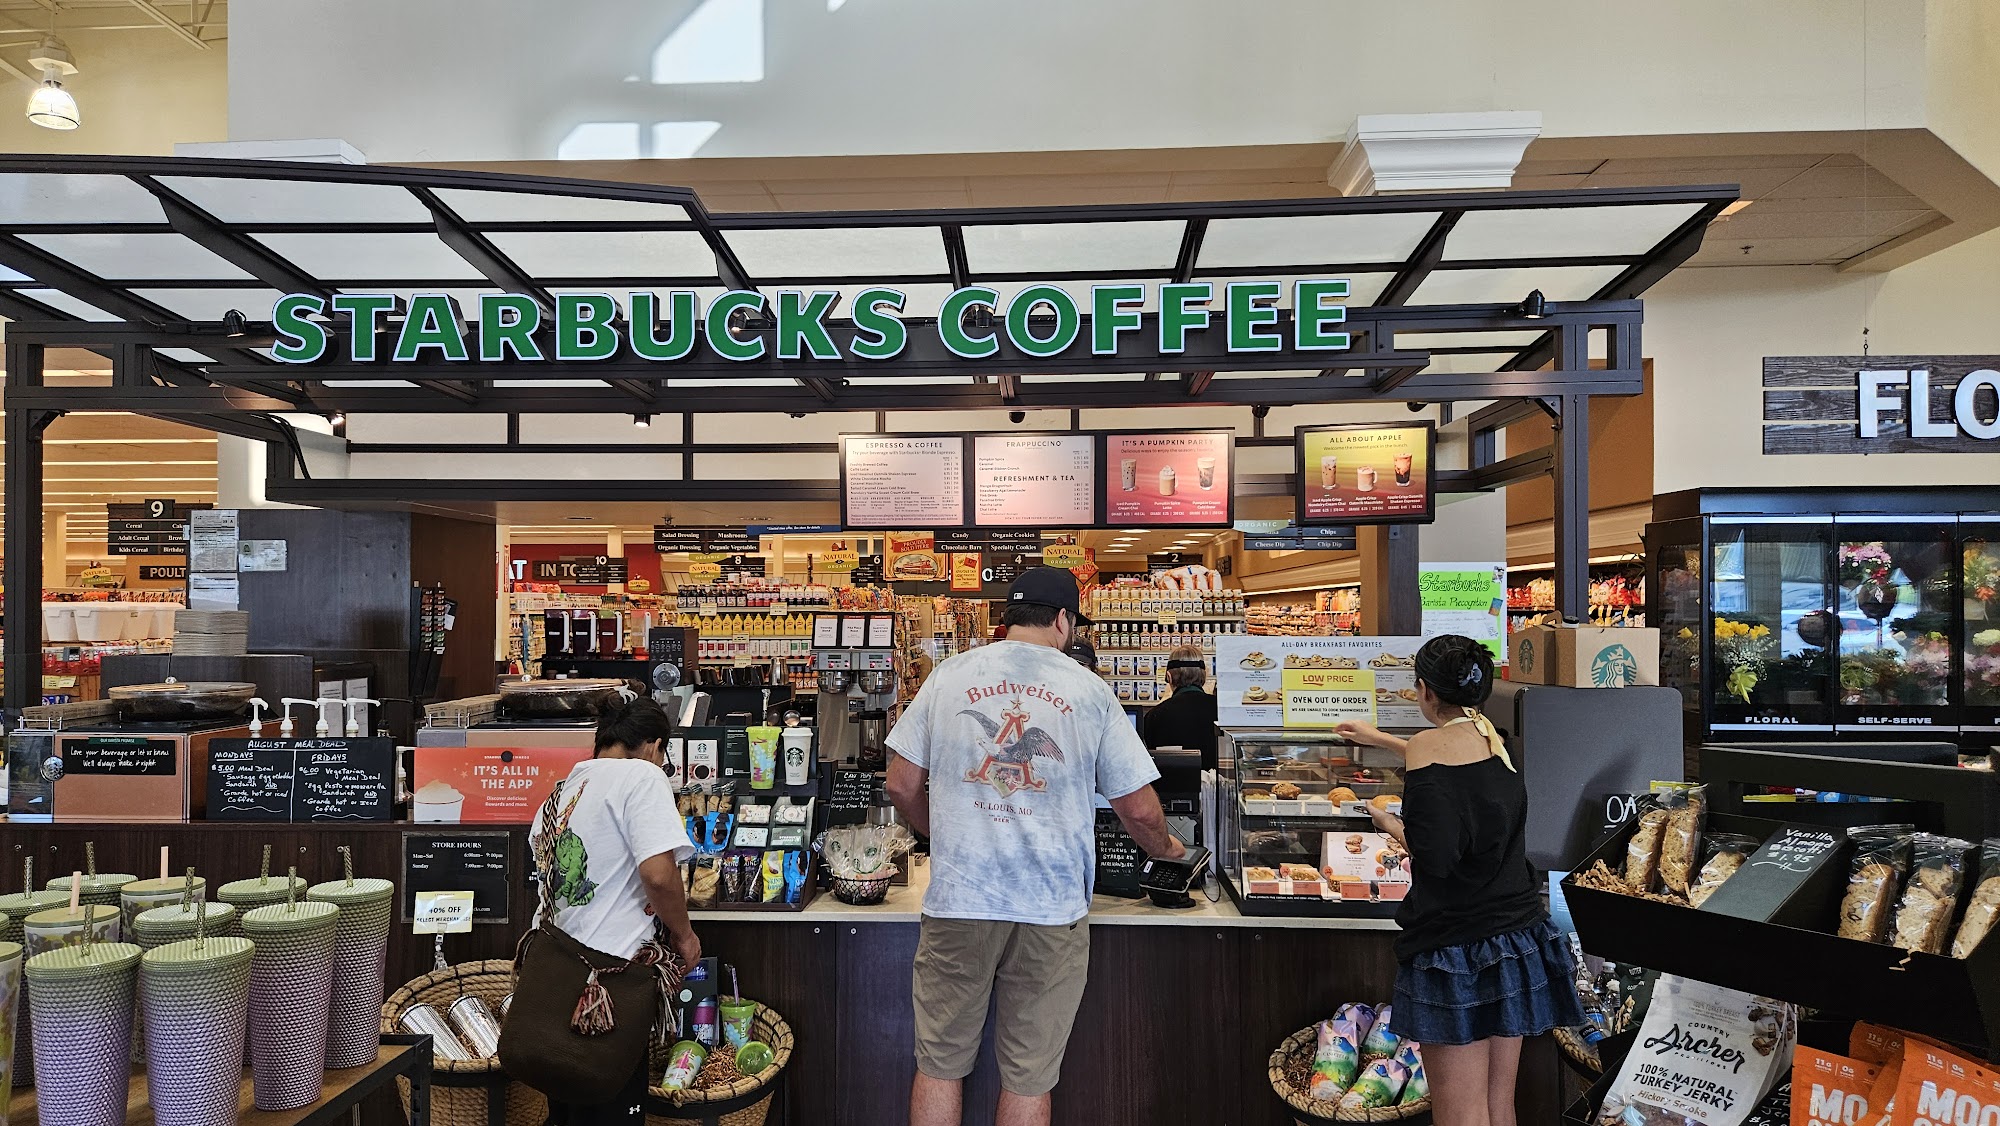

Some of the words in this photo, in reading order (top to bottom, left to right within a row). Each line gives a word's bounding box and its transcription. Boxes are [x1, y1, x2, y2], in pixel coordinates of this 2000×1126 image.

[270, 287, 908, 364] STARBUCKS
[938, 279, 1351, 358] COFFEE
[1857, 369, 2000, 440] FLO
[151, 501, 164, 518] 9
[596, 556, 606, 565] 10
[735, 556, 741, 564] 8
[874, 556, 880, 564] 6
[1015, 555, 1022, 564] 4
[1172, 554, 1179, 562] 2
[150, 567, 186, 577] POULT
[541, 564, 556, 576] IN
[1419, 572, 1490, 592] Starbucks
[965, 679, 1073, 717] Budweiser
[1745, 716, 1798, 724] FLORAL
[1858, 716, 1932, 724] SELF-SERVE
[248, 741, 287, 749] AUGUST
[71, 746, 82, 755] Love
[86, 750, 99, 758] your
[101, 749, 128, 761] beverage
[215, 751, 254, 759] MONDAYS
[97, 760, 116, 771] always
[502, 766, 522, 776] ALL
[527, 766, 539, 776] IN
[227, 774, 255, 783] Sausage
[259, 774, 271, 784] Egg
[325, 768, 364, 779] Vegetarian
[308, 783, 322, 793] Egg
[481, 779, 505, 789] THE
[508, 779, 533, 789] APP
[974, 801, 985, 809] ST.
[1019, 807, 1032, 815] MO
[1606, 796, 1637, 823] OA
[1787, 829, 1833, 841] Vanilla
[1778, 837, 1835, 848] Almond
[1688, 1022, 1730, 1039] COUNTRY
[1644, 1023, 1745, 1074] Archer
[1640, 1064, 1669, 1078] 100%
[1672, 1072, 1735, 1101] NATURAL
[1633, 1074, 1682, 1093] TURKEY
[1683, 1088, 1734, 1112] JERKY
[1638, 1090, 1671, 1106] Hickory
[1672, 1100, 1707, 1118] Smoke
